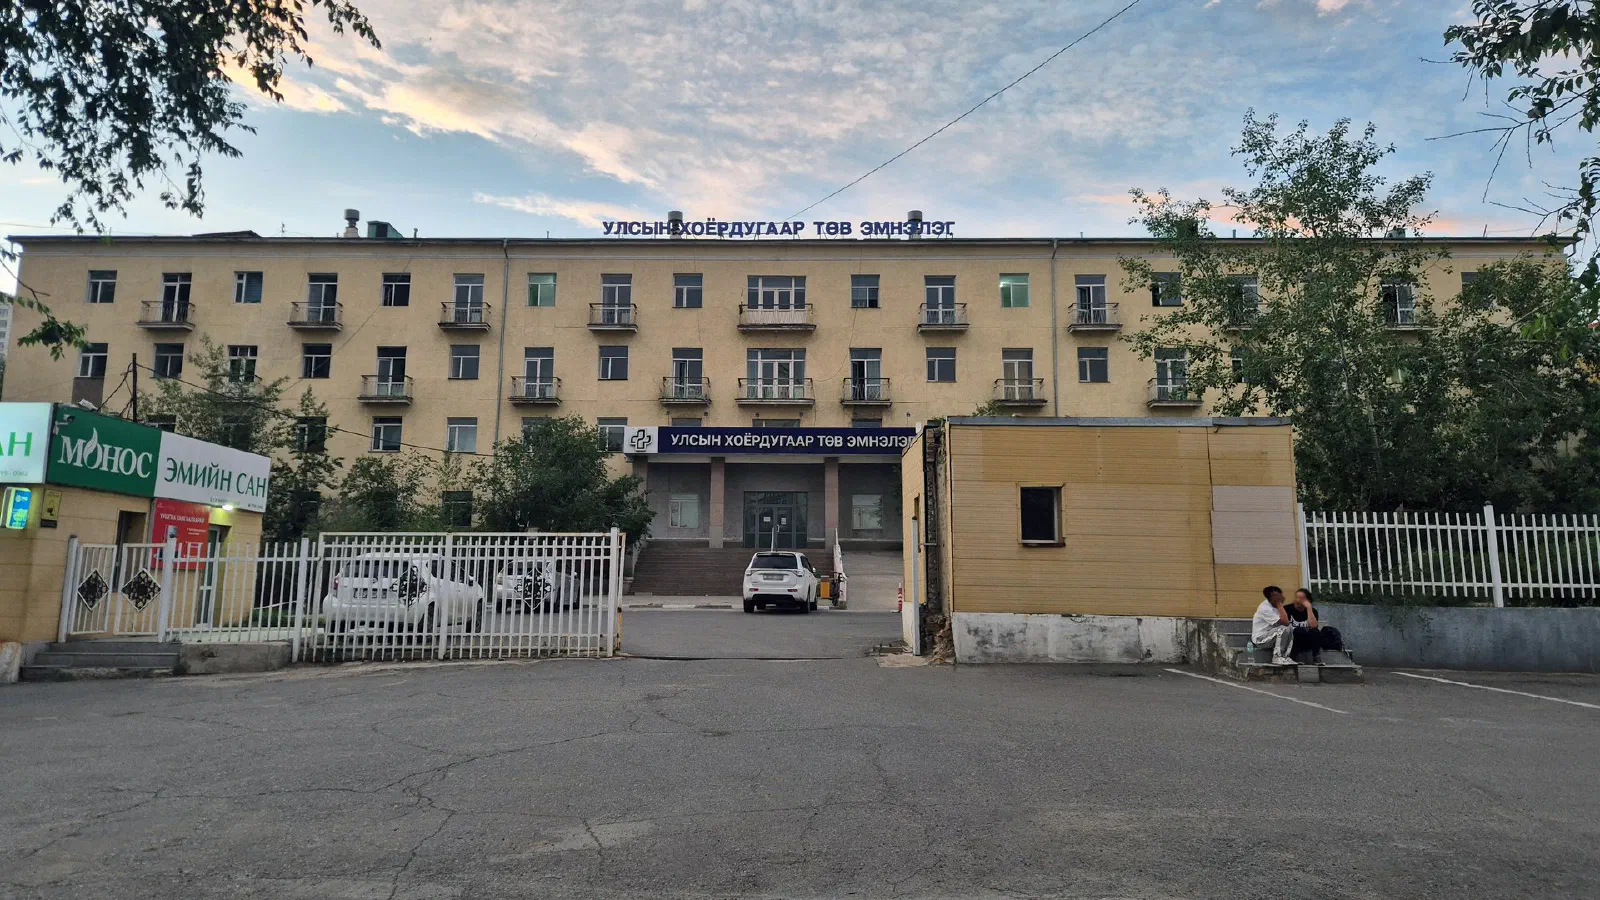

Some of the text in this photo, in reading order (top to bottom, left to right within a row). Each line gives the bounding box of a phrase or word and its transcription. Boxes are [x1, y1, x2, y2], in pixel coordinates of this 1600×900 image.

[602, 218, 955, 238] УЛСЫН ХОЁРДУГААР ТӨВ ЭМНЭЛЭГ
[0, 431, 33, 457] Н
[57, 427, 153, 479] МОНОС
[671, 434, 721, 447] УЛСЫН
[724, 431, 815, 449] ХОЁРДУГААР
[817, 435, 843, 448] ТӨВ
[164, 457, 267, 498] ЭМИЙН САН
